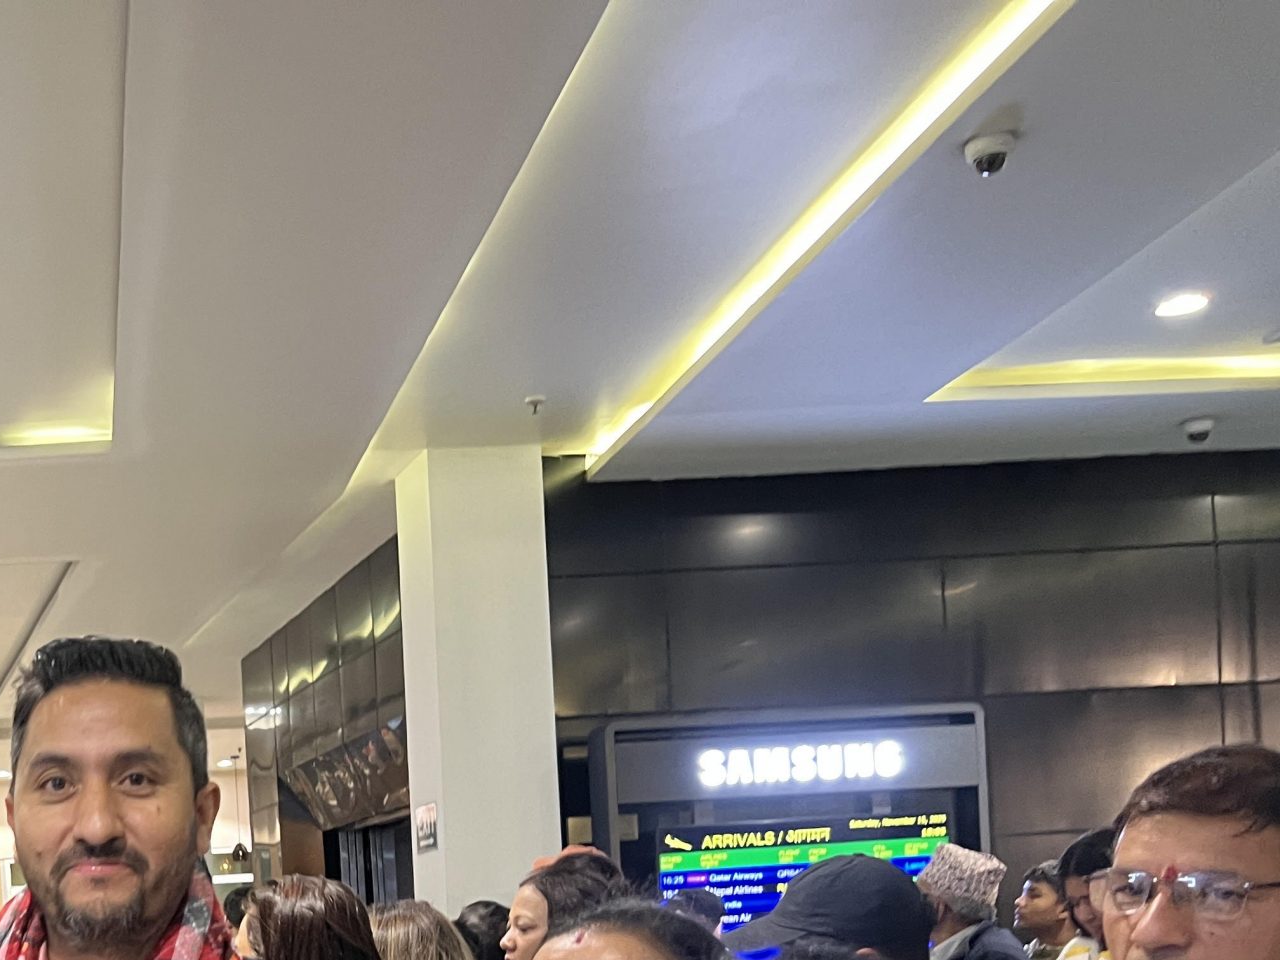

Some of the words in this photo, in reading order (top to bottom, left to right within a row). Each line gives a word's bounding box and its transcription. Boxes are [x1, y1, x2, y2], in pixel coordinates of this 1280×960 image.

[698, 740, 902, 787] SAMSUNG
[701, 829, 775, 850] ARRIVALS
[709, 873, 731, 883] Qatar
[733, 871, 763, 882] Airways
[734, 884, 763, 896] Airlines
[724, 900, 742, 910] ndia
[739, 912, 753, 923] Air
